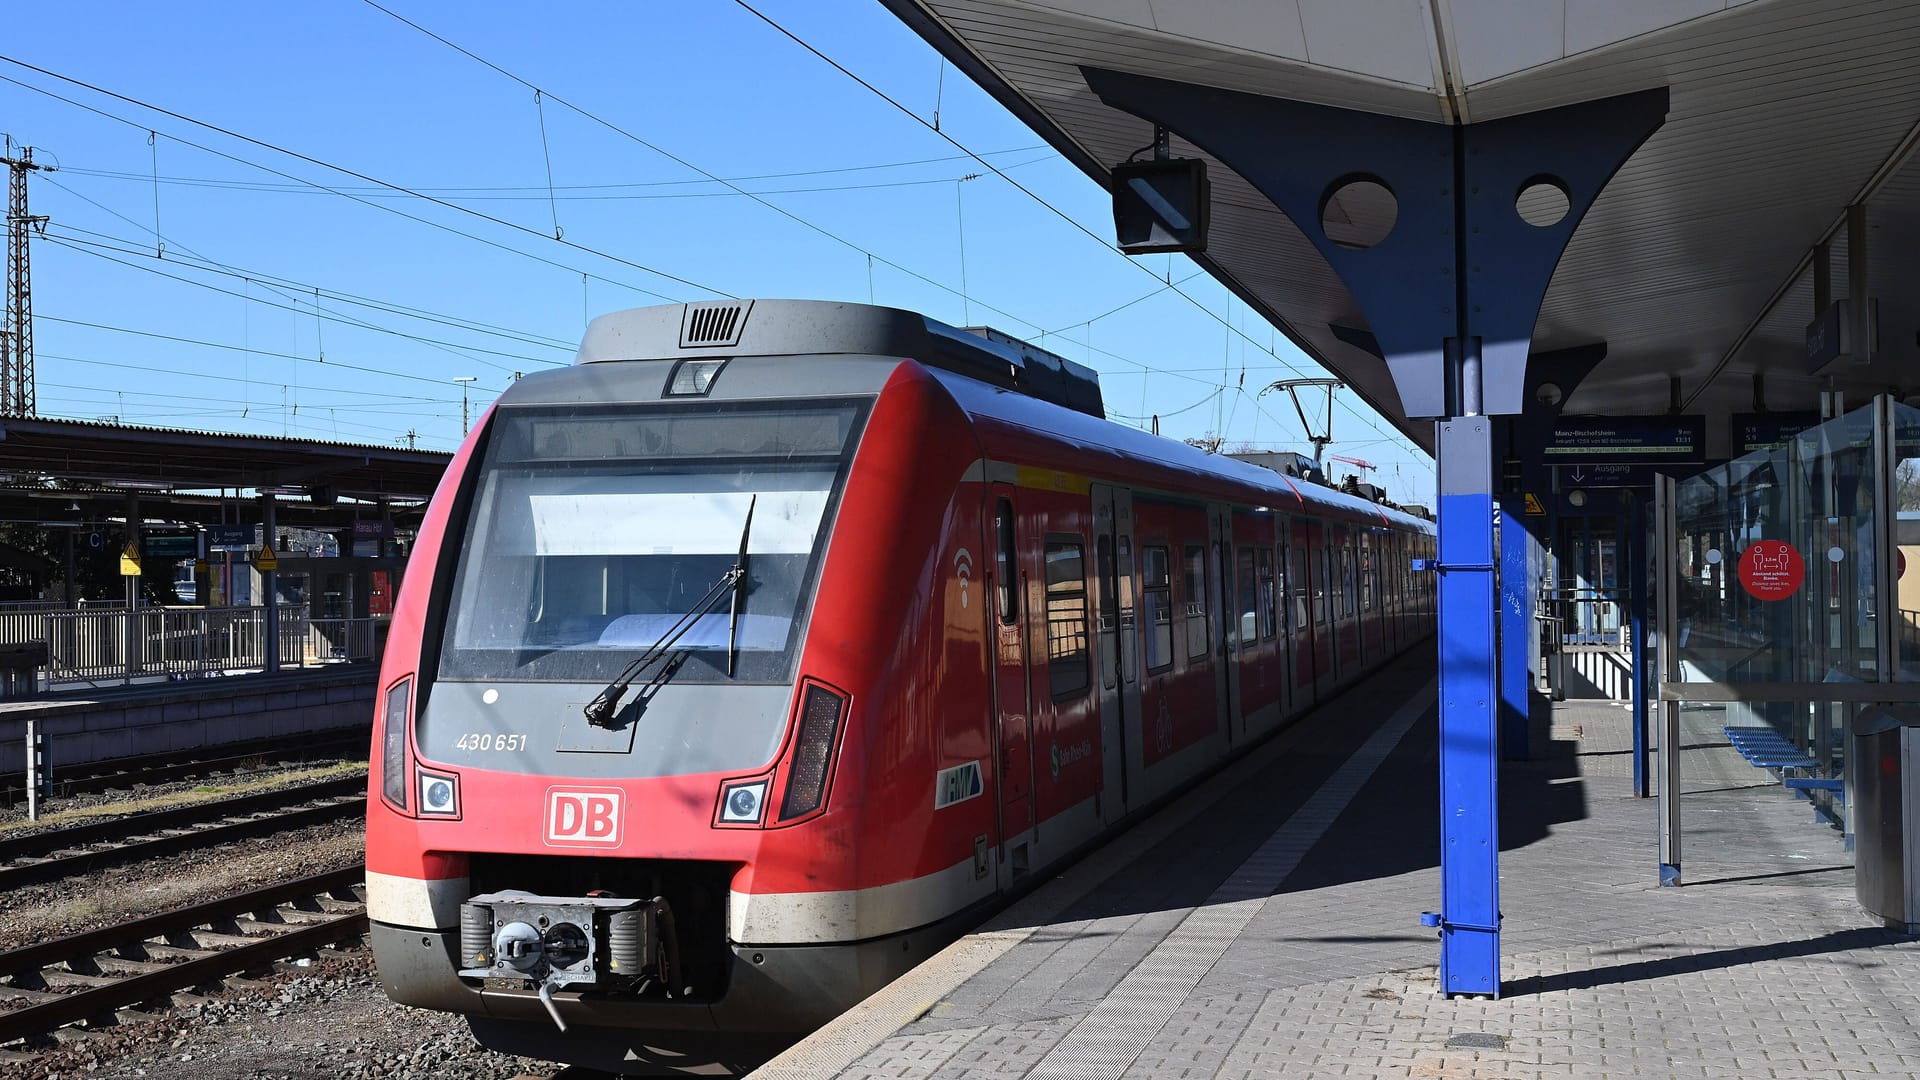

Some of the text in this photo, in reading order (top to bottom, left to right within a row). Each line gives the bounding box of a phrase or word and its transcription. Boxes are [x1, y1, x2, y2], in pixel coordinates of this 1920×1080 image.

[1594, 465, 1630, 474] Ausgang
[90, 532, 100, 548] C
[457, 733, 527, 752] 430 651
[554, 796, 614, 837] DB
